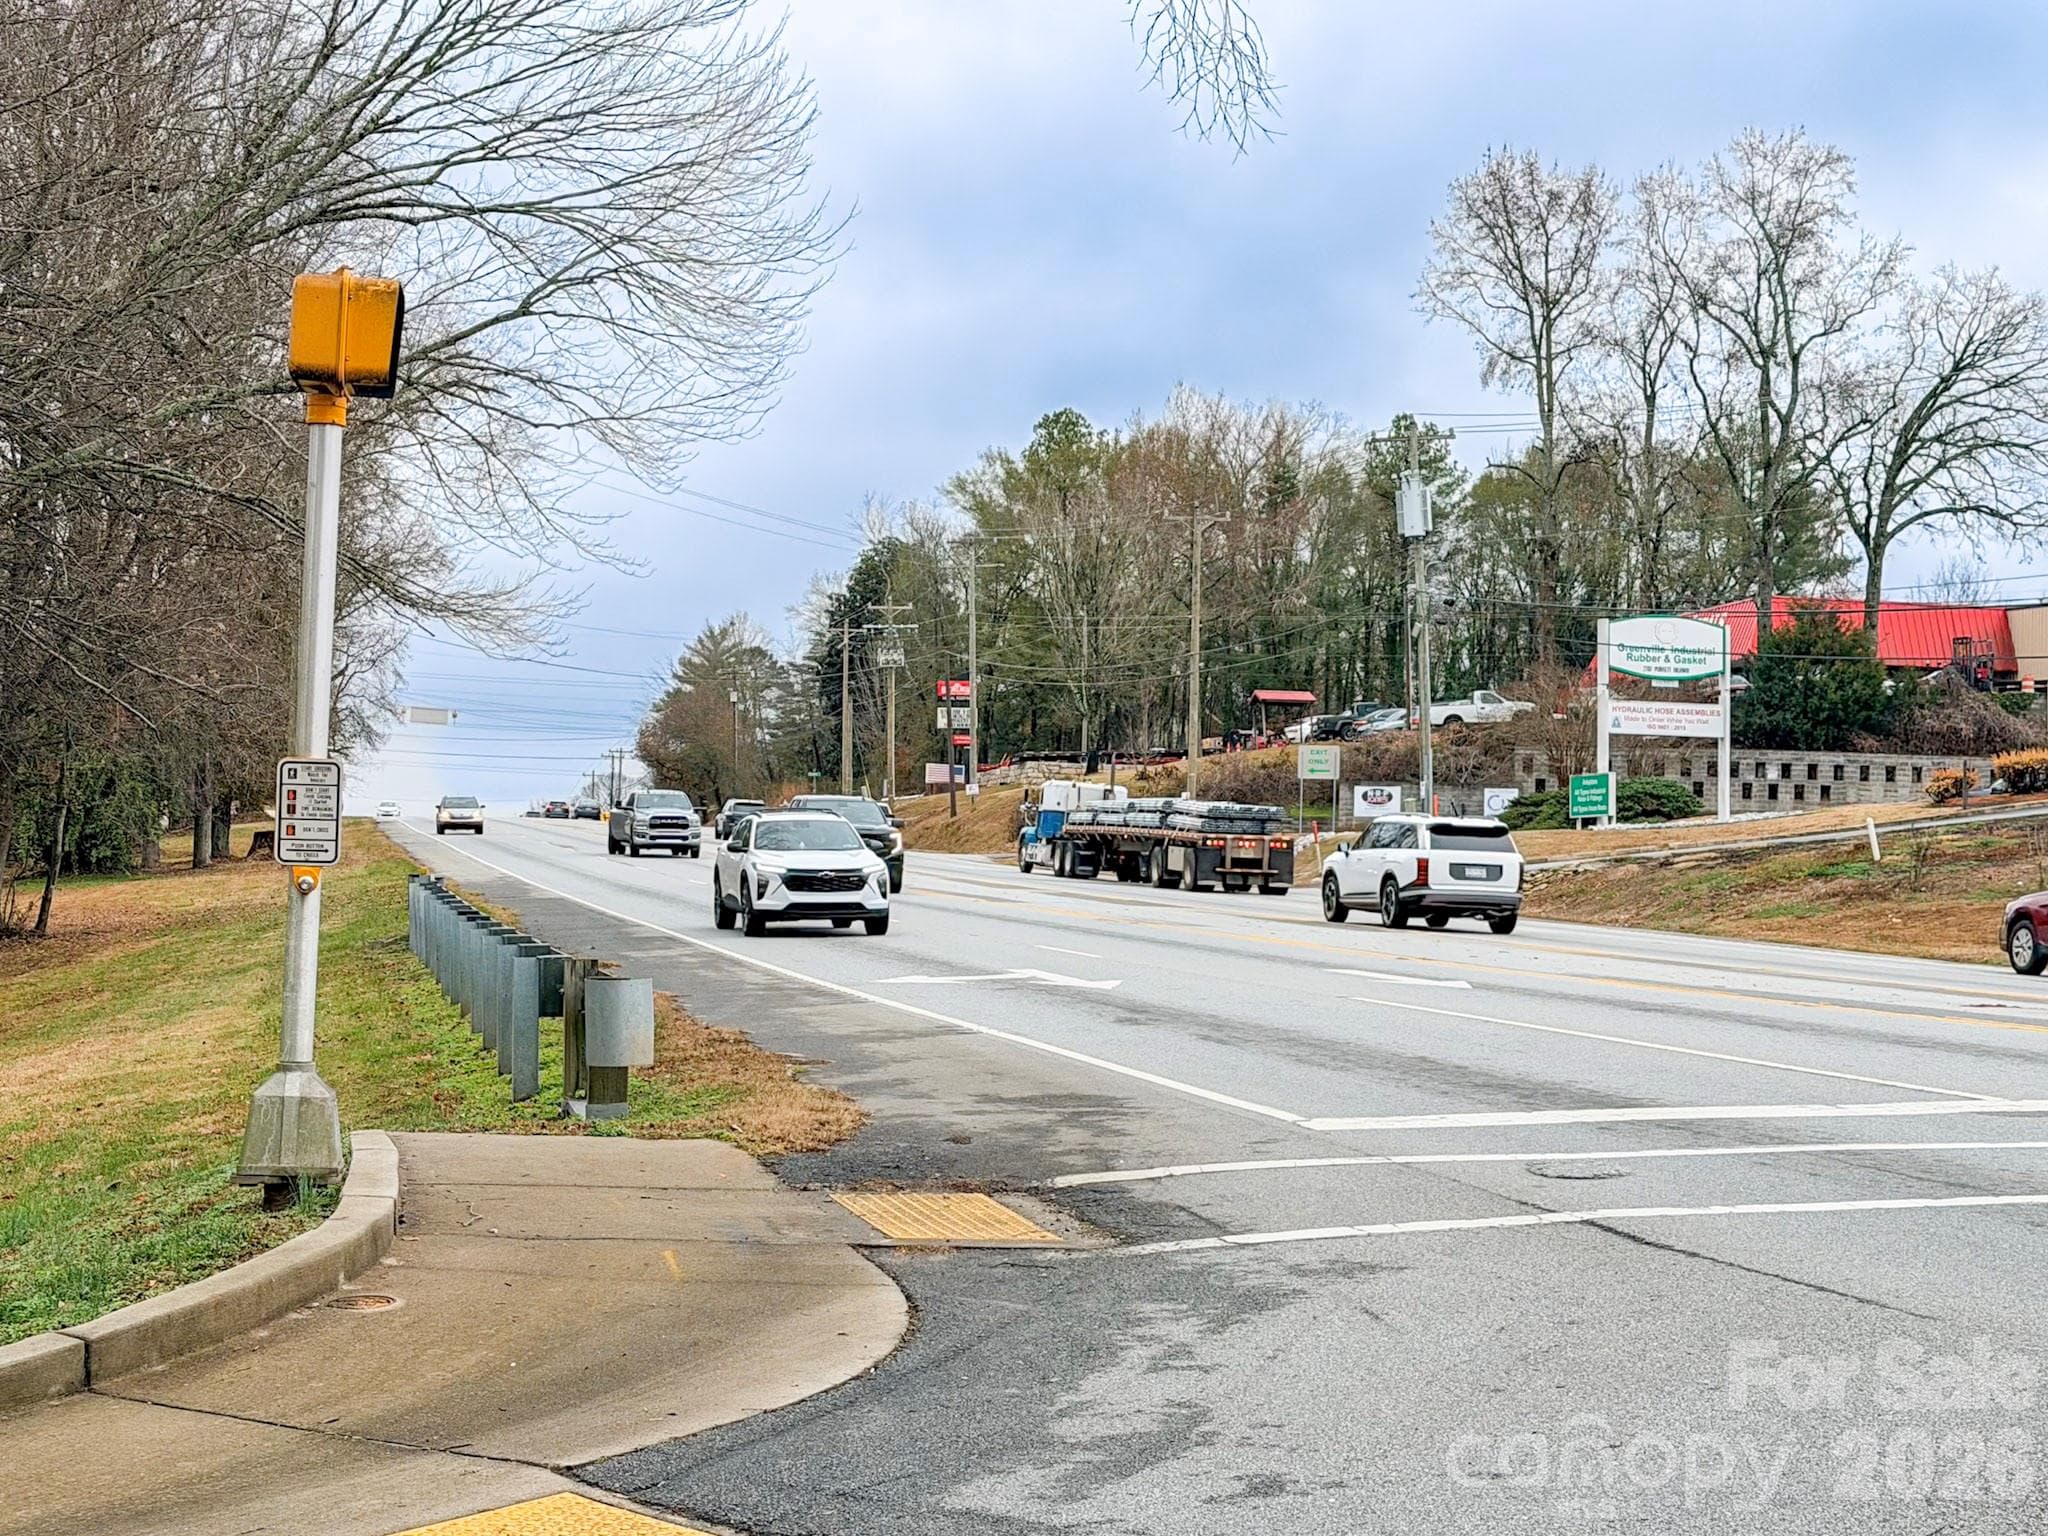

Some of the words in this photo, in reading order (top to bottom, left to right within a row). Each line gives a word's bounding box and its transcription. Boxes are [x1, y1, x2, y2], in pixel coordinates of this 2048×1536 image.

[1617, 643, 1665, 654] Greenville
[1671, 645, 1716, 656] Industrial
[1626, 652, 1661, 663] Rubber
[1664, 654, 1671, 663] &
[1673, 655, 1707, 665] Gasket
[1612, 706, 1653, 714] HYDRAULIC
[1655, 707, 1673, 715] HOSE
[1676, 708, 1721, 717] ASSEMBLIES
